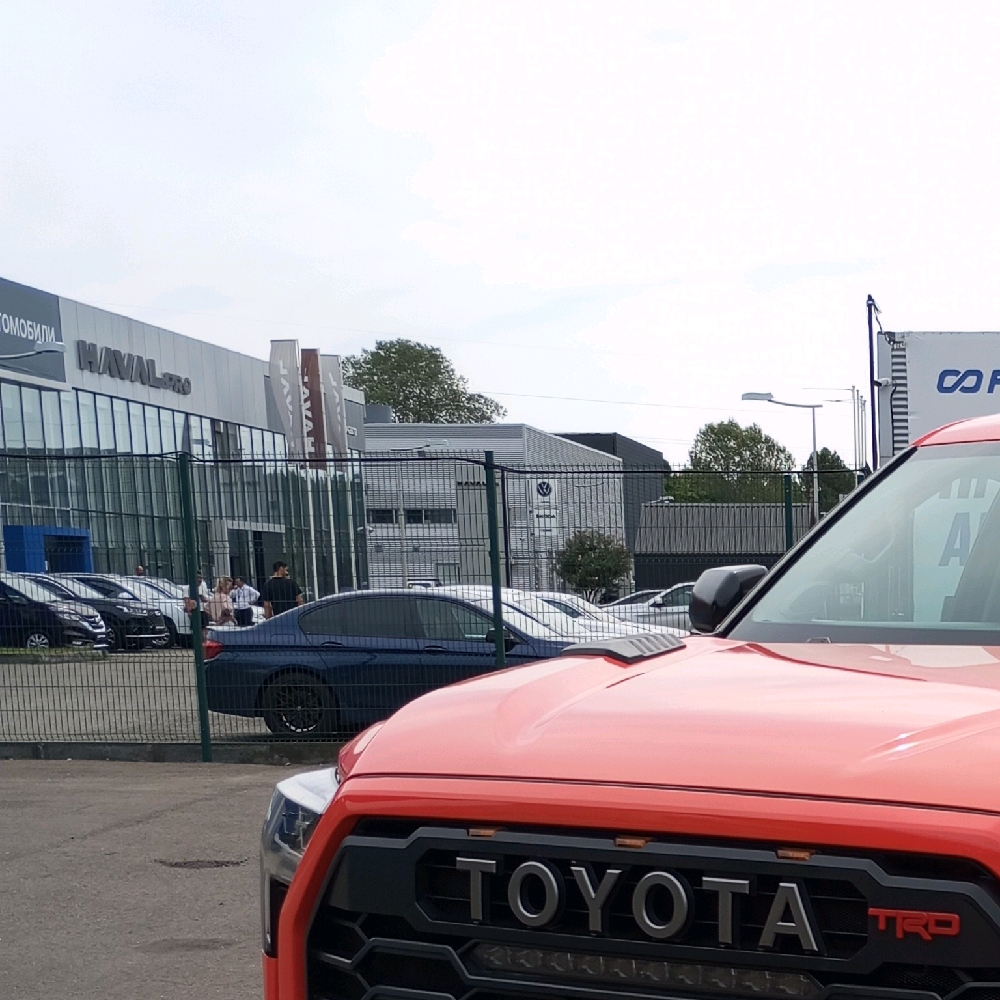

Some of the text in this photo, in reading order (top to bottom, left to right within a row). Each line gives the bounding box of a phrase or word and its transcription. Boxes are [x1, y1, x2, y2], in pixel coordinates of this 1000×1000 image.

[0, 312, 56, 343] ОМОБИЛИ
[77, 340, 161, 389] HAVAL
[455, 855, 820, 953] TOYOTA
[868, 907, 961, 941] TRD
